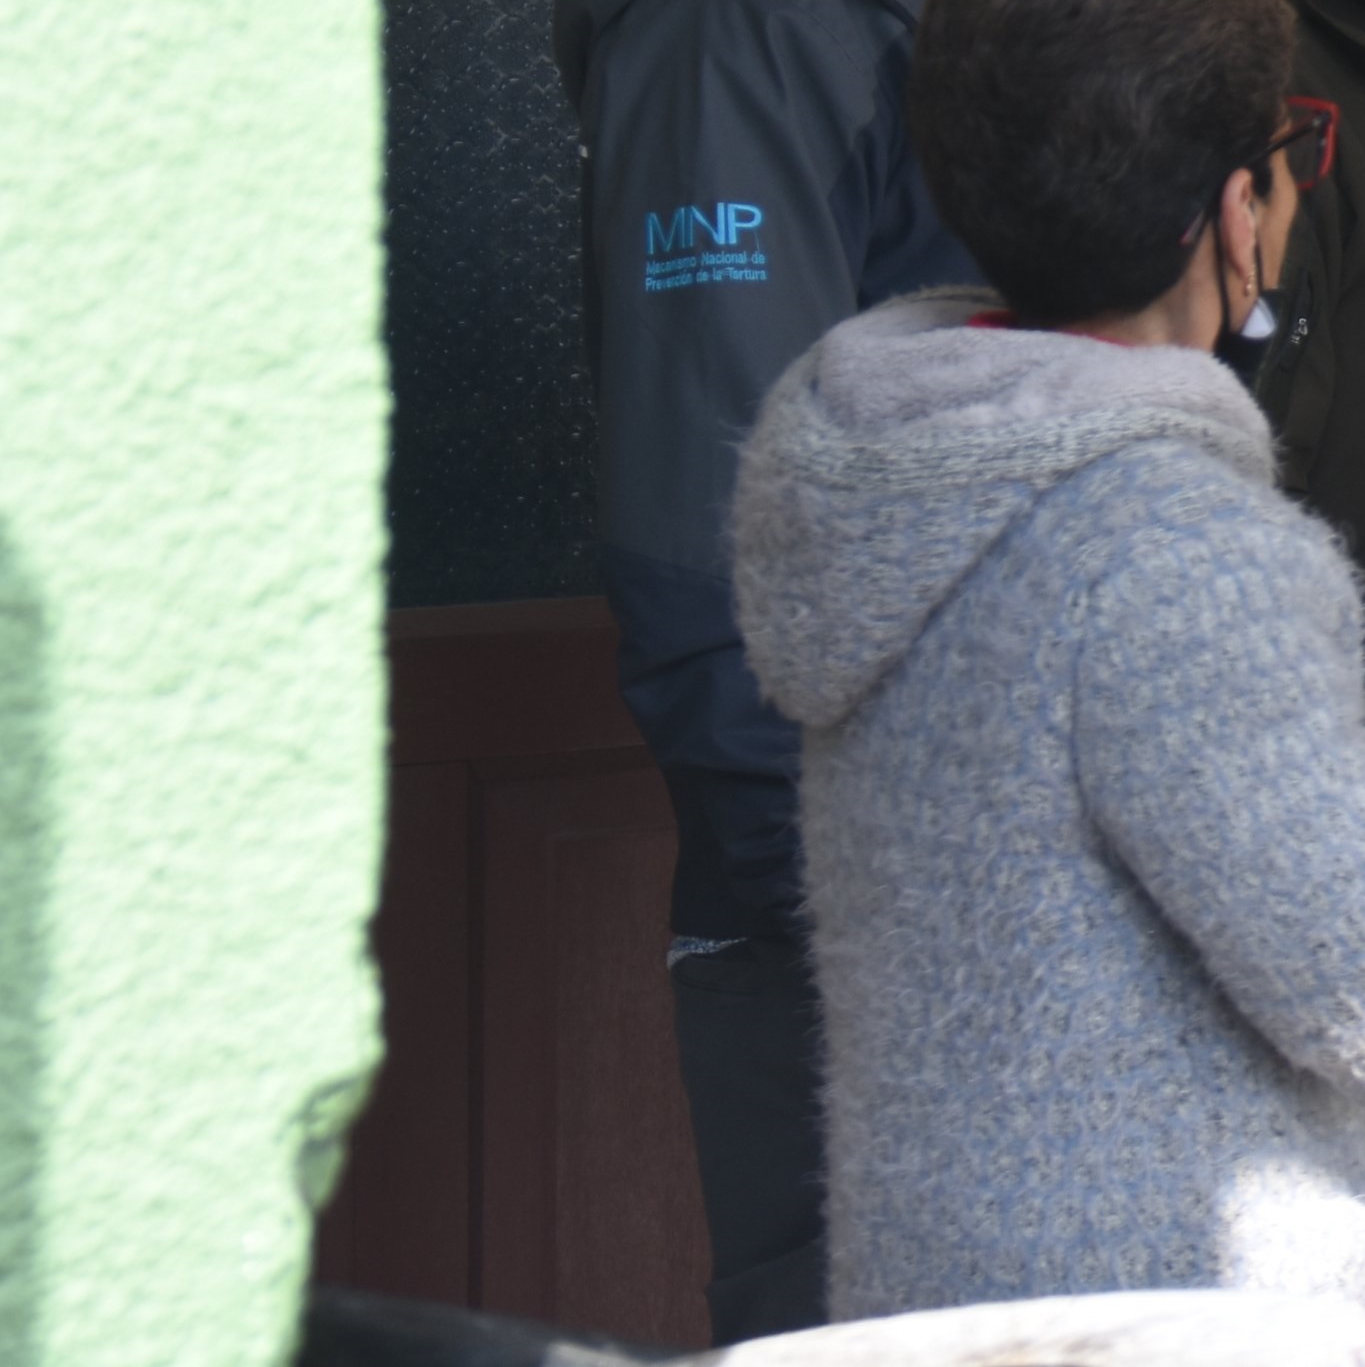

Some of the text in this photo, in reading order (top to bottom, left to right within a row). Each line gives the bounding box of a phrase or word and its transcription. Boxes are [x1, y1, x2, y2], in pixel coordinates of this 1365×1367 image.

[646, 201, 763, 256] MNP
[701, 250, 747, 266] Nacional
[751, 250, 766, 265] de
[696, 270, 710, 283] de
